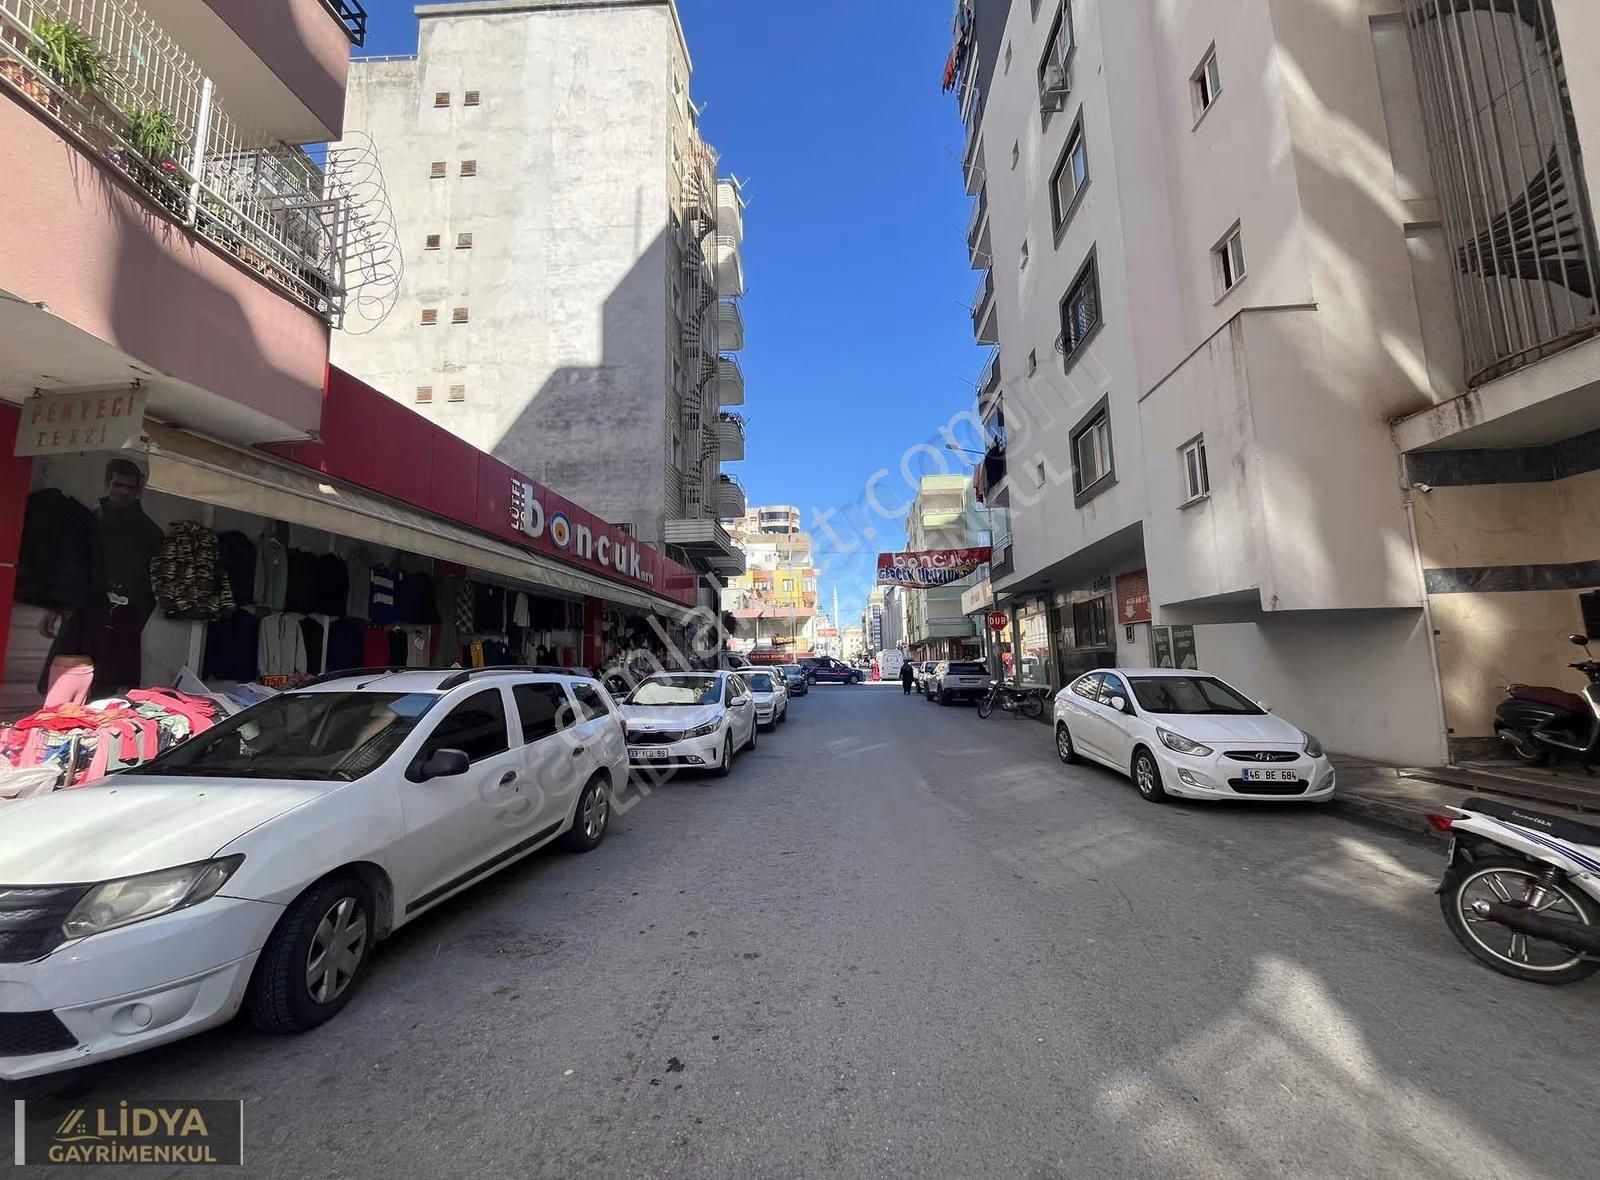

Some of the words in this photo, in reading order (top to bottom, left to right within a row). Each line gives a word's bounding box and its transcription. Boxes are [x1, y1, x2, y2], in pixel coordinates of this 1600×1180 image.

[522, 483, 641, 580] boncuk
[989, 616, 1006, 625] DUR
[1249, 770, 1260, 780] 46
[1265, 770, 1277, 780] BE
[1281, 770, 1297, 780] 684
